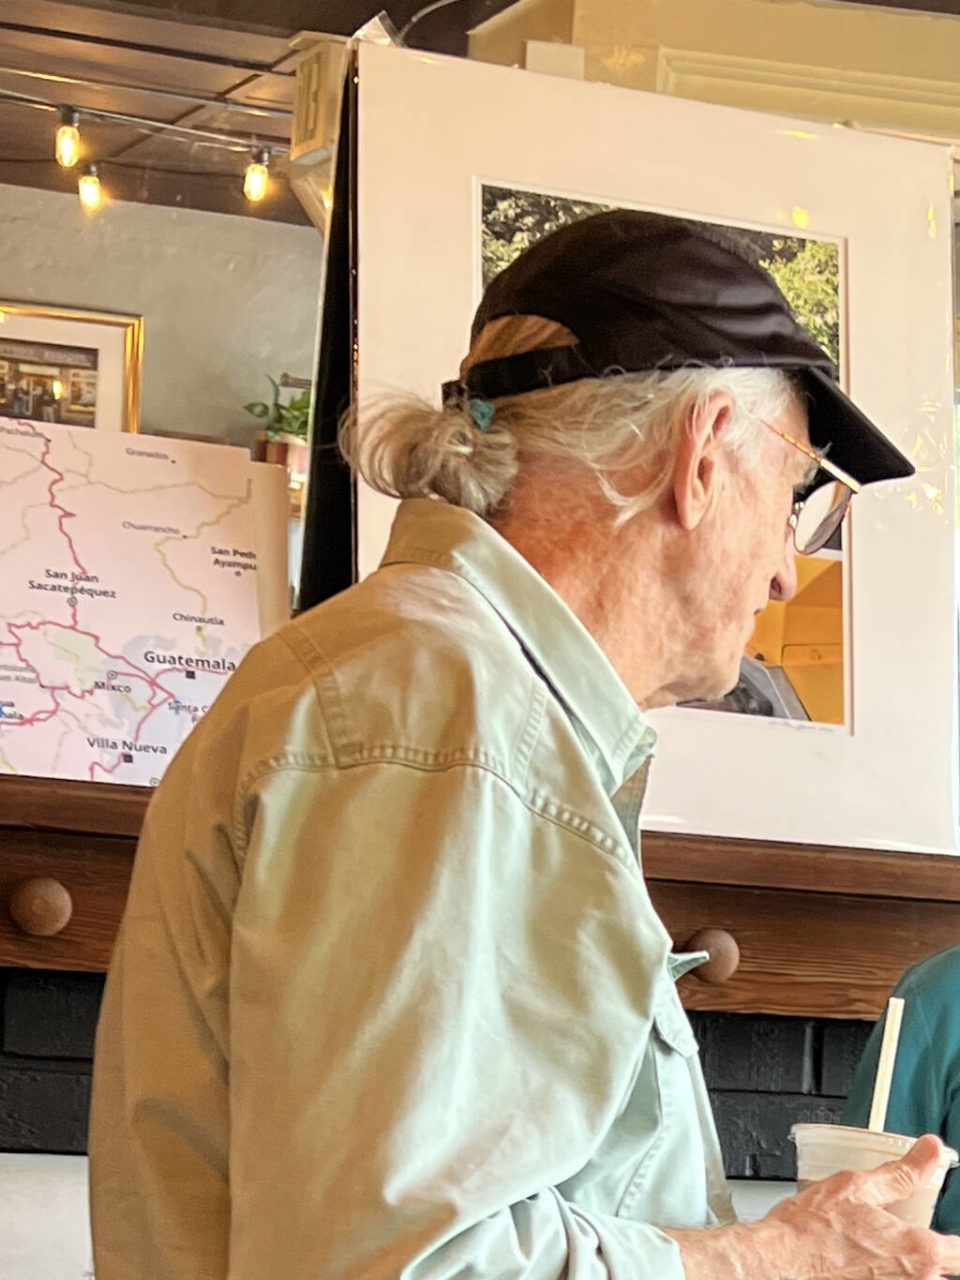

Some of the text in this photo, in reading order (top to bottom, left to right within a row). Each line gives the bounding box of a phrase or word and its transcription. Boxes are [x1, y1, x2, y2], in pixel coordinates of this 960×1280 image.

[211, 546, 230, 556] San
[45, 568, 99, 583] San Juan
[28, 580, 116, 599] Sacatepéquez
[144, 650, 236, 671] Guatemala
[94, 681, 131, 693] Mixco
[87, 737, 167, 754] Villa Nueva
